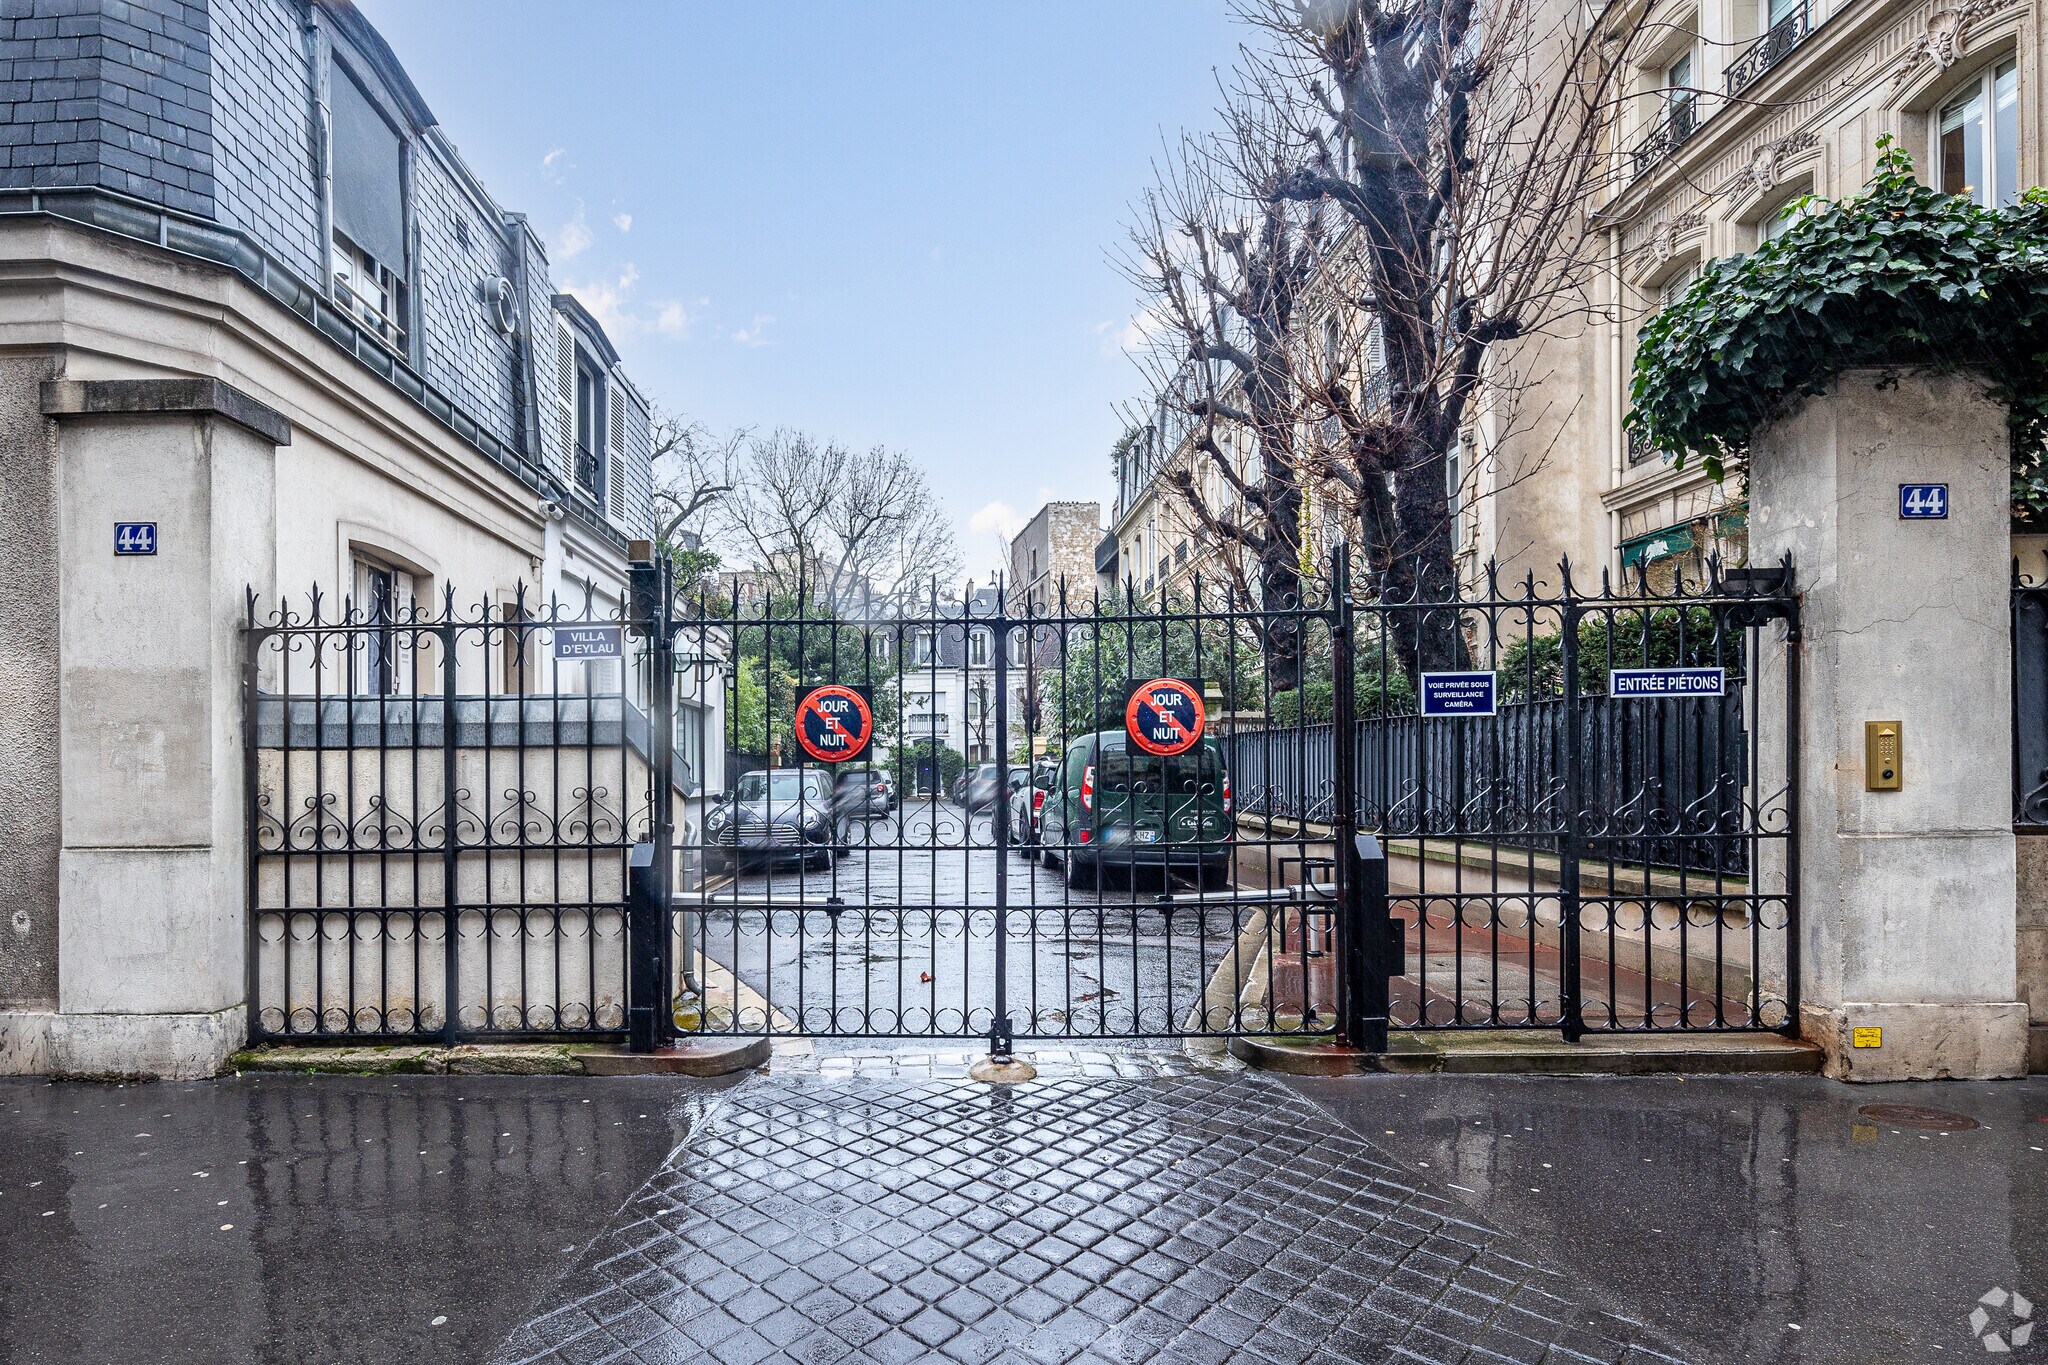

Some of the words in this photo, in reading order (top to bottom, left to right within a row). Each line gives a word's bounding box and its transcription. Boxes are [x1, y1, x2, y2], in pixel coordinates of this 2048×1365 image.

[1905, 488, 1944, 514] 44
[117, 526, 152, 550] 44
[570, 632, 606, 642] VILLA
[562, 643, 614, 655] D'EYLAU
[1445, 680, 1469, 689] PRIVÉE
[1618, 674, 1665, 691] ENTRÉE
[1667, 673, 1719, 690] PIÉTONS
[1150, 693, 1182, 706] JOUR
[1433, 691, 1484, 699] SURVEILLANCE
[817, 700, 849, 713] JOUR
[1444, 700, 1474, 708] CAMÉRA
[1159, 710, 1175, 723] ET
[825, 717, 841, 730] ET
[819, 733, 847, 747] NUIT
[1153, 727, 1180, 740] NUIT
